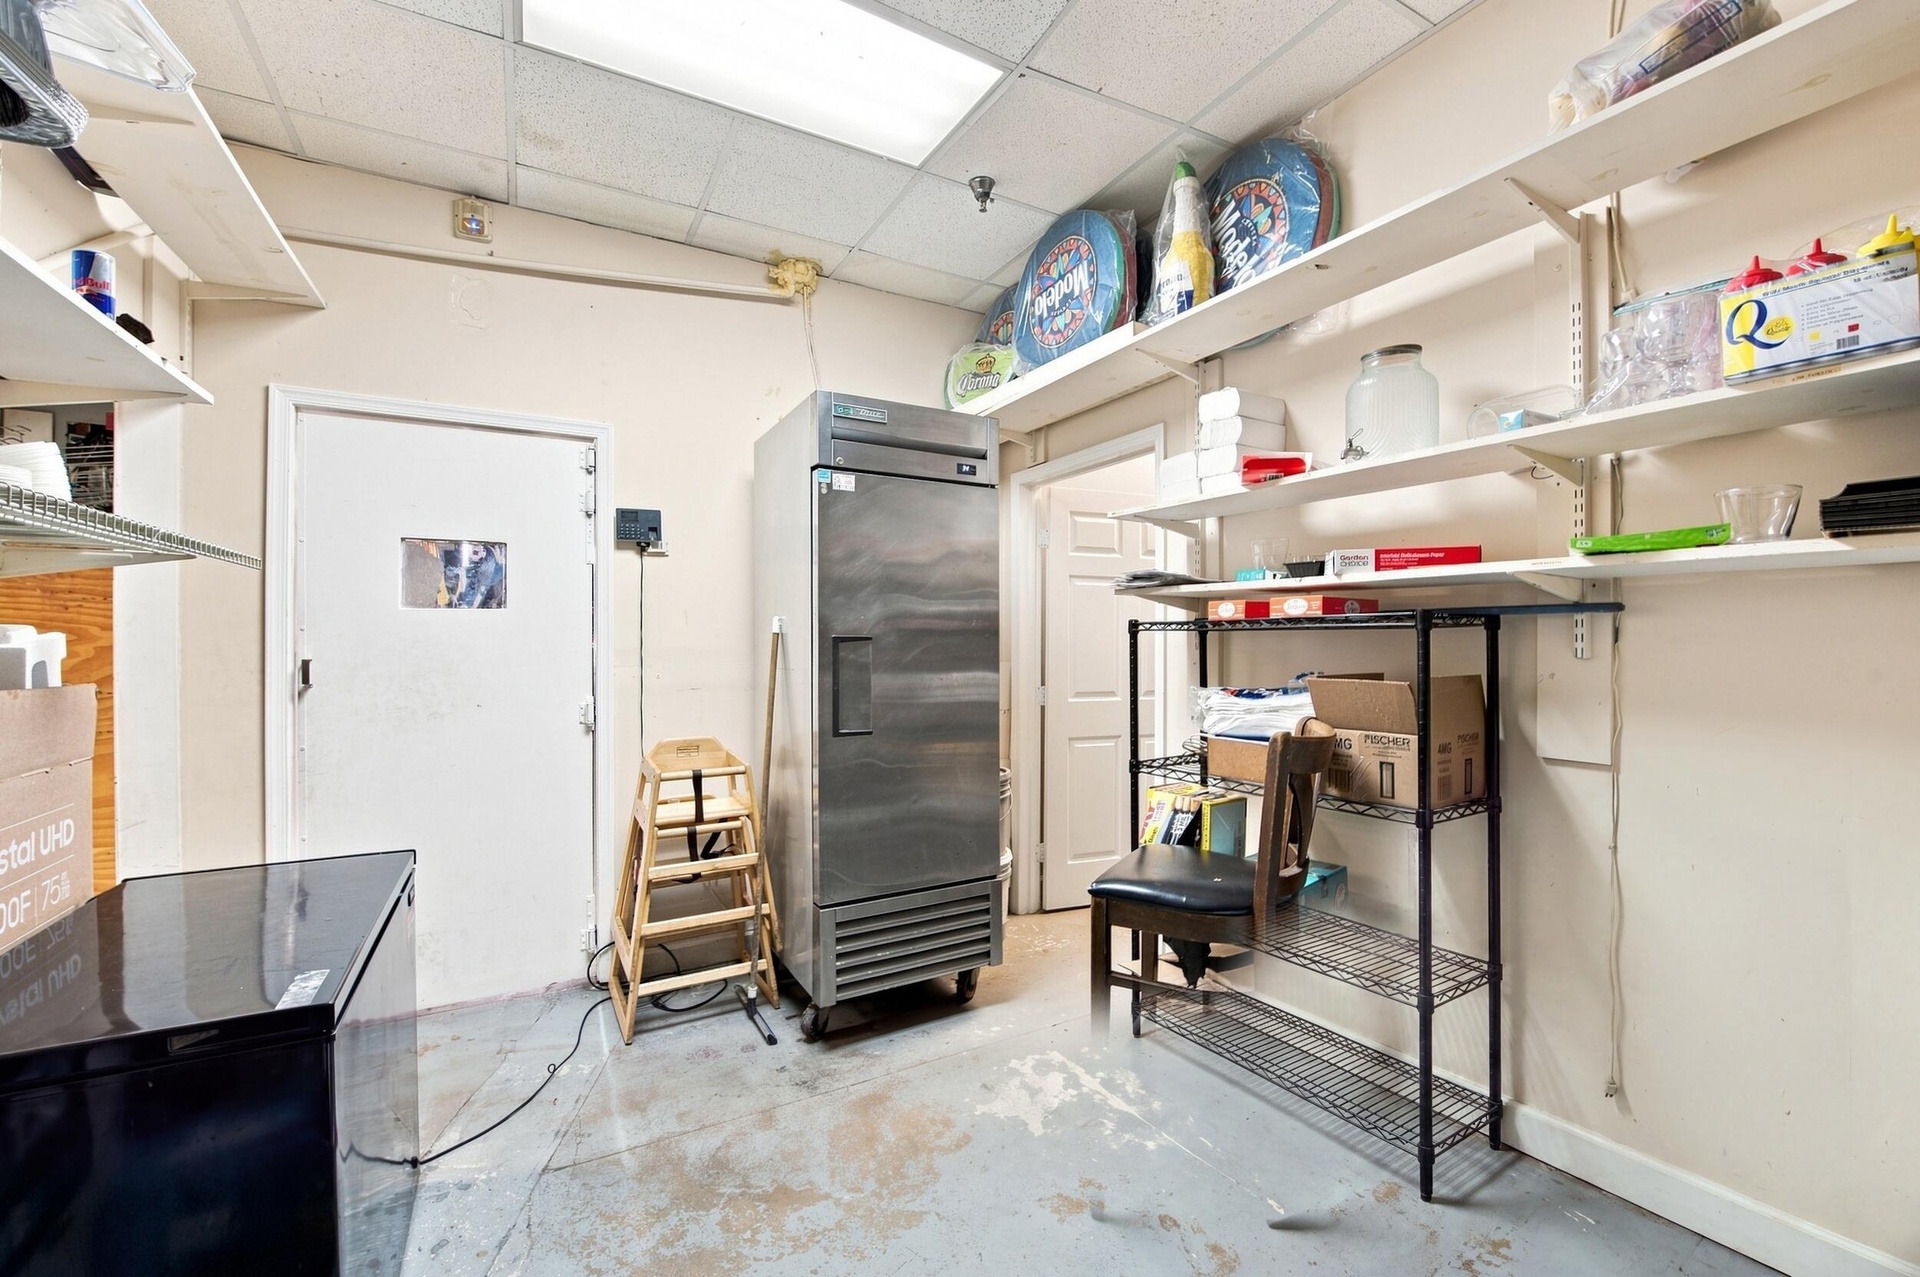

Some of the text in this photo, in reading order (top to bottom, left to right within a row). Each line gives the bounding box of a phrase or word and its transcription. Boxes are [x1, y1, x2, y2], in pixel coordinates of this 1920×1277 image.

[1034, 260, 1090, 319] Modelo
[1726, 299, 1791, 349] Q
[957, 373, 1000, 397] Corona
[40, 818, 75, 856] UHD
[41, 875, 61, 911] 75
